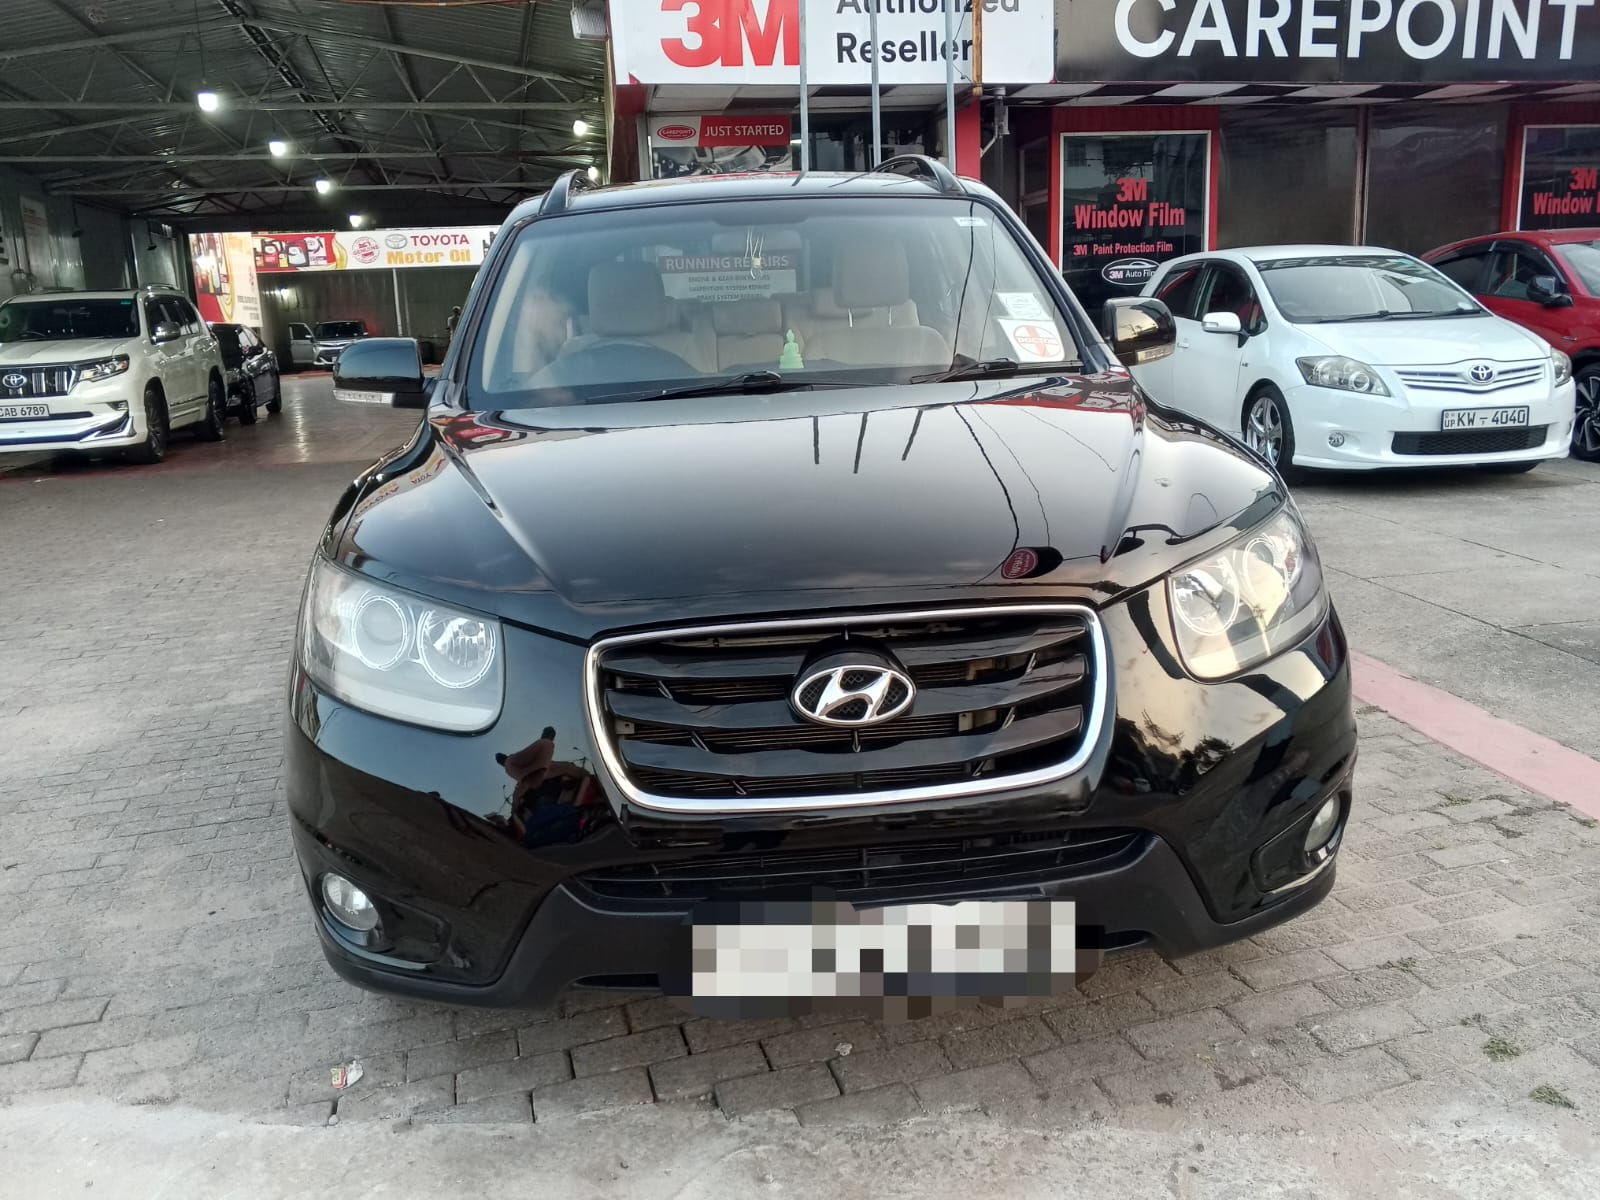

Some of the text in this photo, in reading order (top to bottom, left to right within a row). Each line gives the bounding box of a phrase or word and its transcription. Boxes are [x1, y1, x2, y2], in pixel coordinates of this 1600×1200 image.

[836, 0, 1020, 14] Authoized
[660, 0, 800, 67] 3M
[1114, 0, 1596, 60] CAREPOINT
[836, 31, 973, 63] Reseller
[705, 124, 785, 137] JUST STARTED
[1569, 167, 1598, 190] 3M
[1116, 178, 1148, 202] 3M
[1533, 191, 1593, 215] Window
[1074, 202, 1185, 229] Window Film
[410, 234, 470, 247] TOYOTA
[1073, 241, 1173, 256] 3M Paint Protection Film
[386, 251, 444, 264] Motor
[450, 248, 471, 262] Oil
[666, 254, 790, 270] RUNNING REAIRS
[1109, 270, 1124, 279] 3M
[1125, 269, 1142, 278] Auto
[20, 406, 46, 416] 6789
[1457, 411, 1476, 427] KW
[1491, 409, 1526, 425] 4040
[1444, 418, 1455, 428] UP
